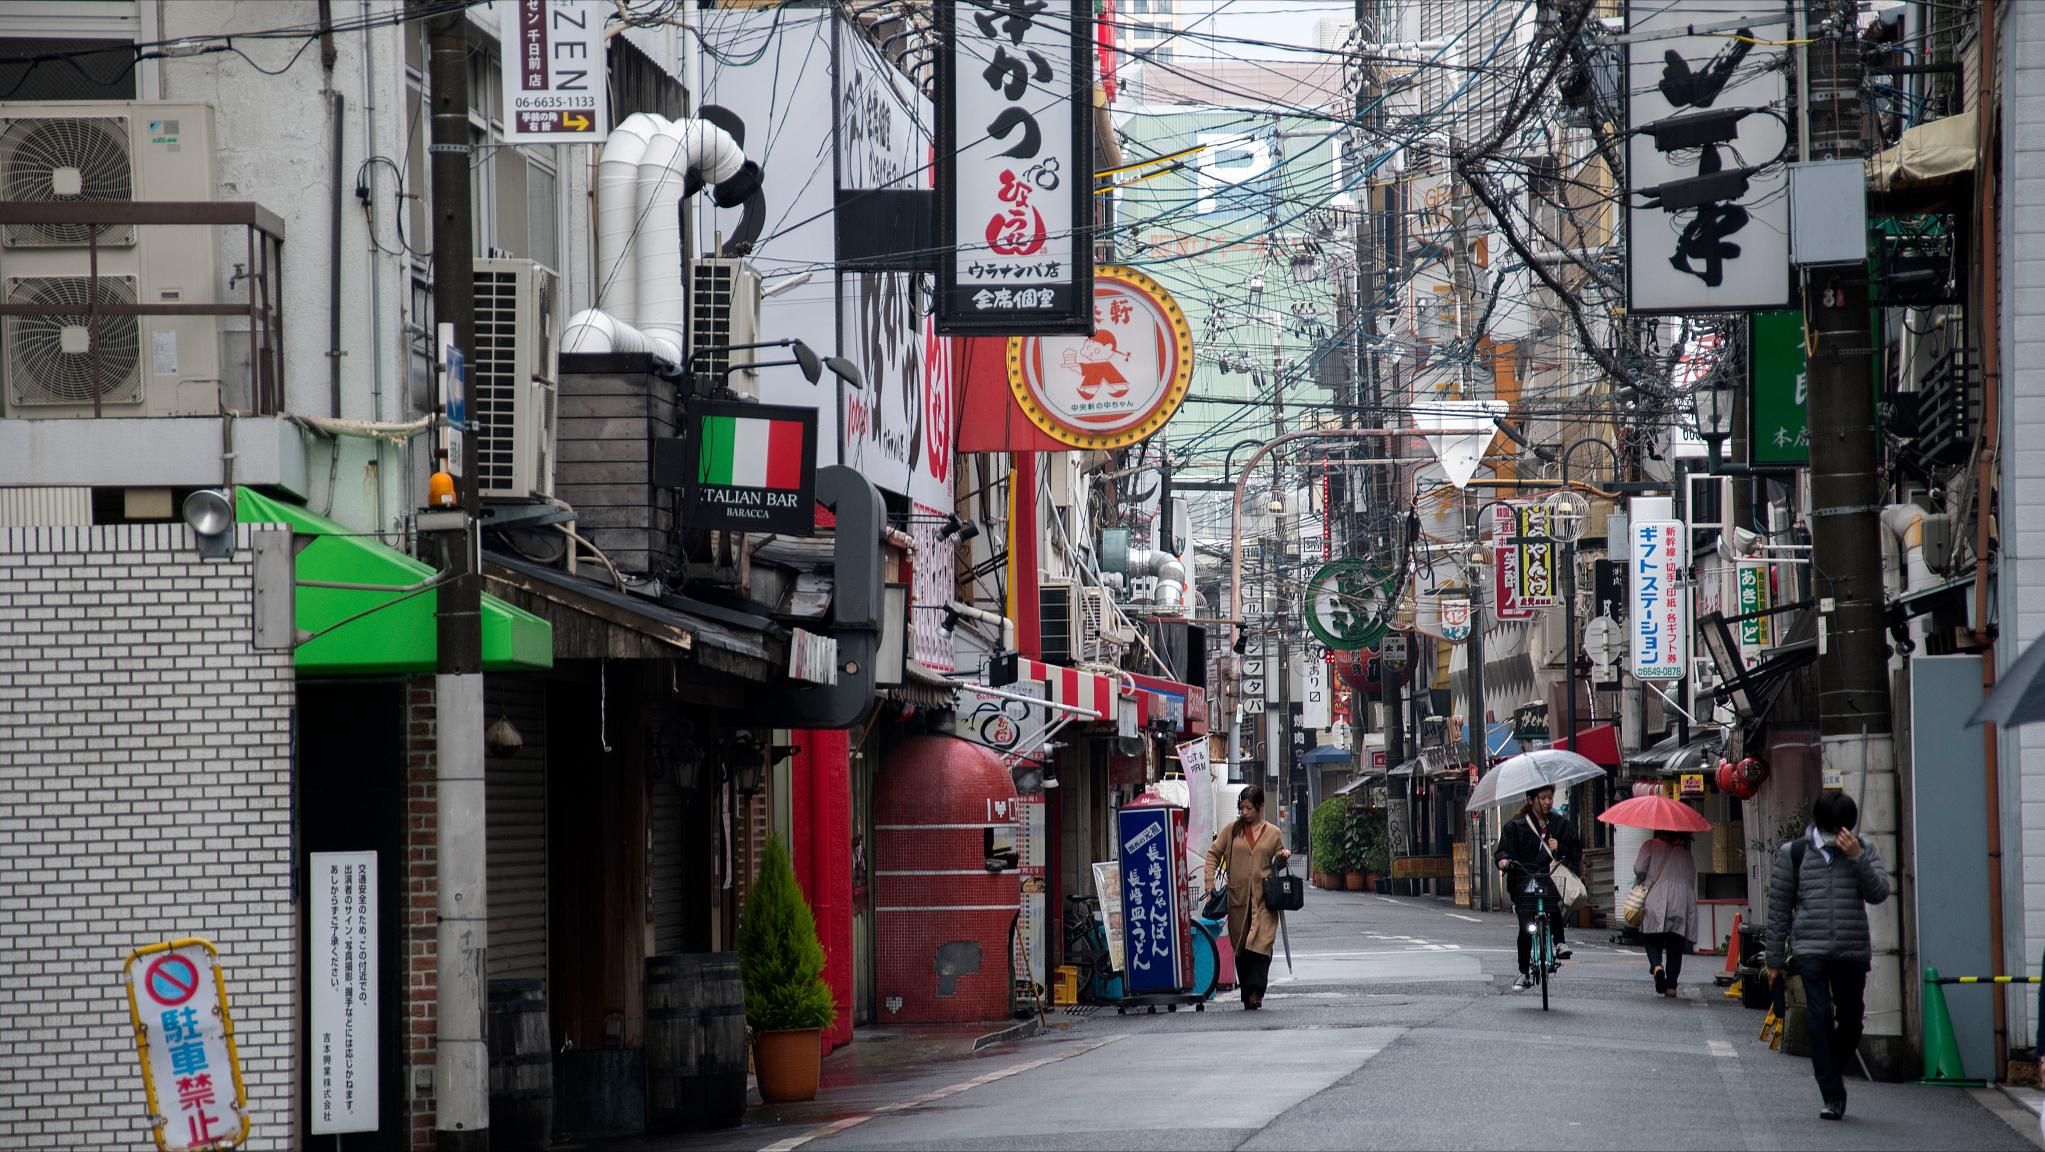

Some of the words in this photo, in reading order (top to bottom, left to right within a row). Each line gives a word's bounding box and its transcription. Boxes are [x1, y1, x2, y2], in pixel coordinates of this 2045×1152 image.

[515, 97, 595, 108] 06-6635-1133
[968, 260, 1061, 279] ウラナンバ店
[972, 287, 1055, 310] 全席個室
[1071, 401, 1134, 411] 中央軒の中ちゃん
[700, 488, 761, 505] TALIAN
[766, 492, 798, 508] BAR
[726, 508, 770, 519] BARACCA
[1640, 526, 1659, 664] ギフトステーション
[330, 865, 339, 993] あしからずご了承ください。
[358, 864, 368, 1007] 交通安全のため、この付近での、
[1127, 869, 1150, 971] 長崎皿うどん
[1146, 843, 1169, 957] 長崎ちゃんぽん
[161, 1006, 224, 1149] 駐車禁止
[322, 1032, 331, 1122] 吉本興業株式会社
